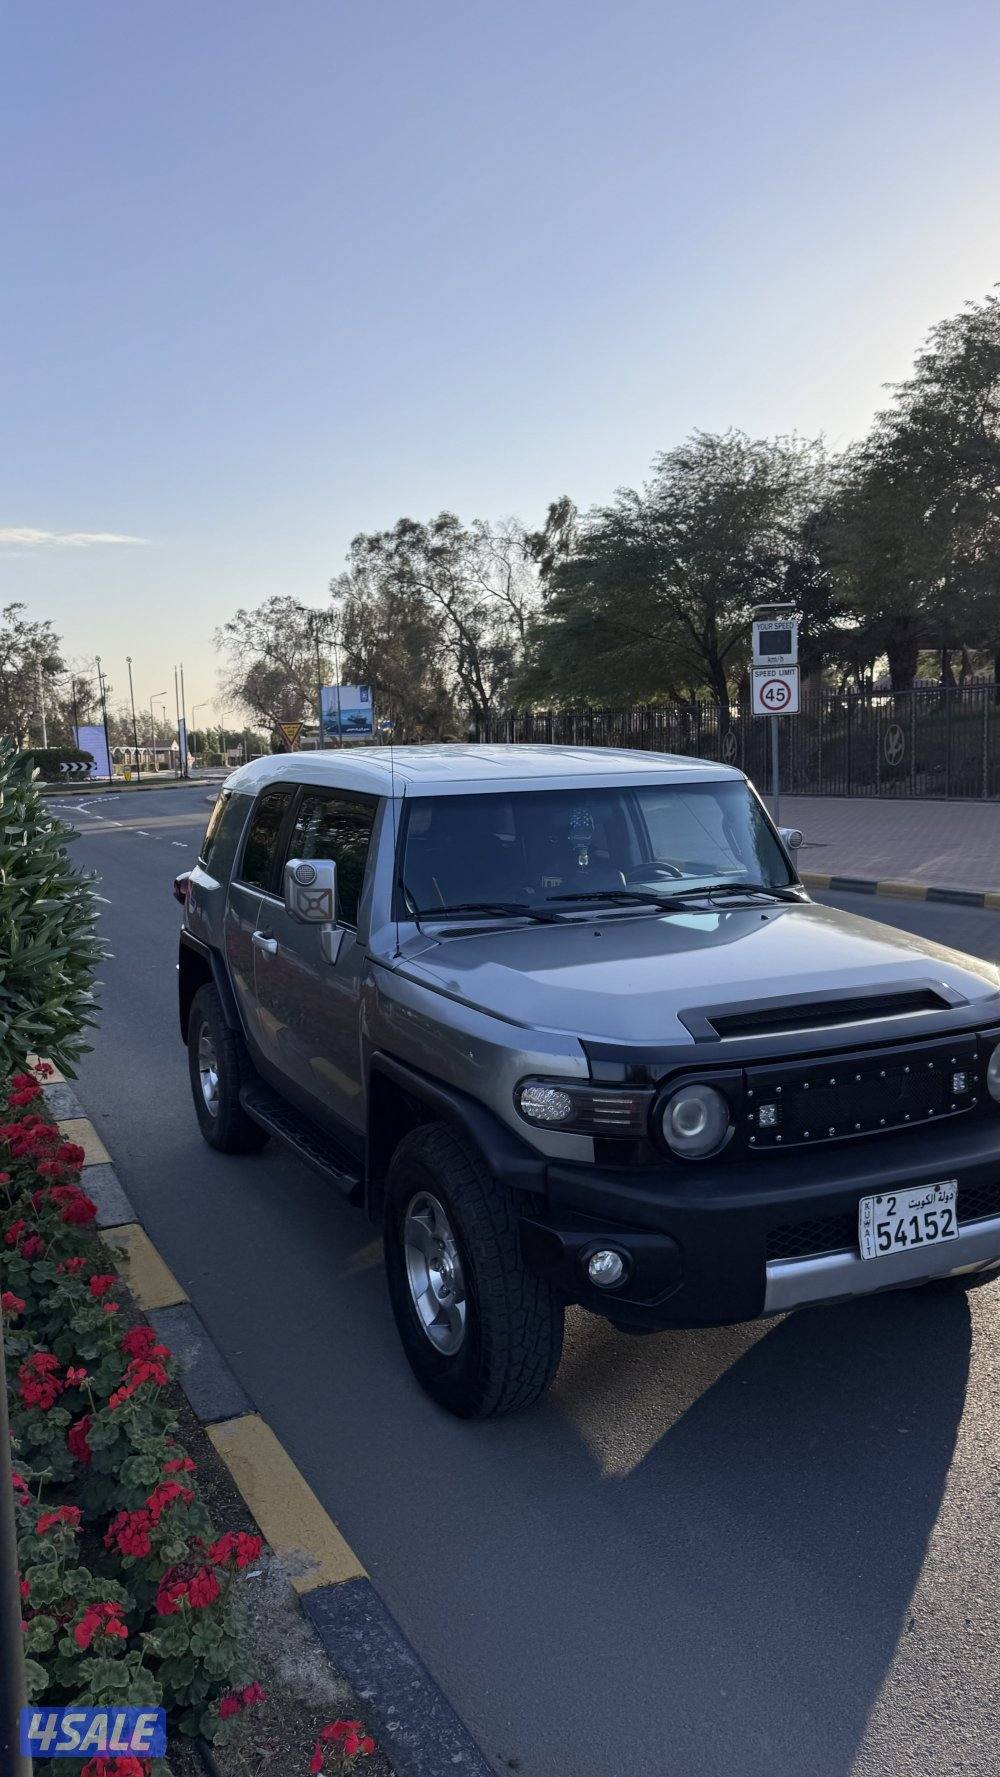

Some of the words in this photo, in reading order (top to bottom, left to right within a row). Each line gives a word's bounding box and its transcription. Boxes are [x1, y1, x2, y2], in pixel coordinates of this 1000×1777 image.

[757, 622, 773, 631] YOUR
[774, 621, 794, 630] SPEED
[754, 670, 776, 678] SPEED
[765, 688, 785, 702] 45
[908, 1192, 936, 1210] الكويت
[938, 1191, 954, 1204] دولة
[886, 1196, 897, 1217] 2
[864, 1201, 873, 1256] KUWAIT
[876, 1208, 955, 1251] 54152
